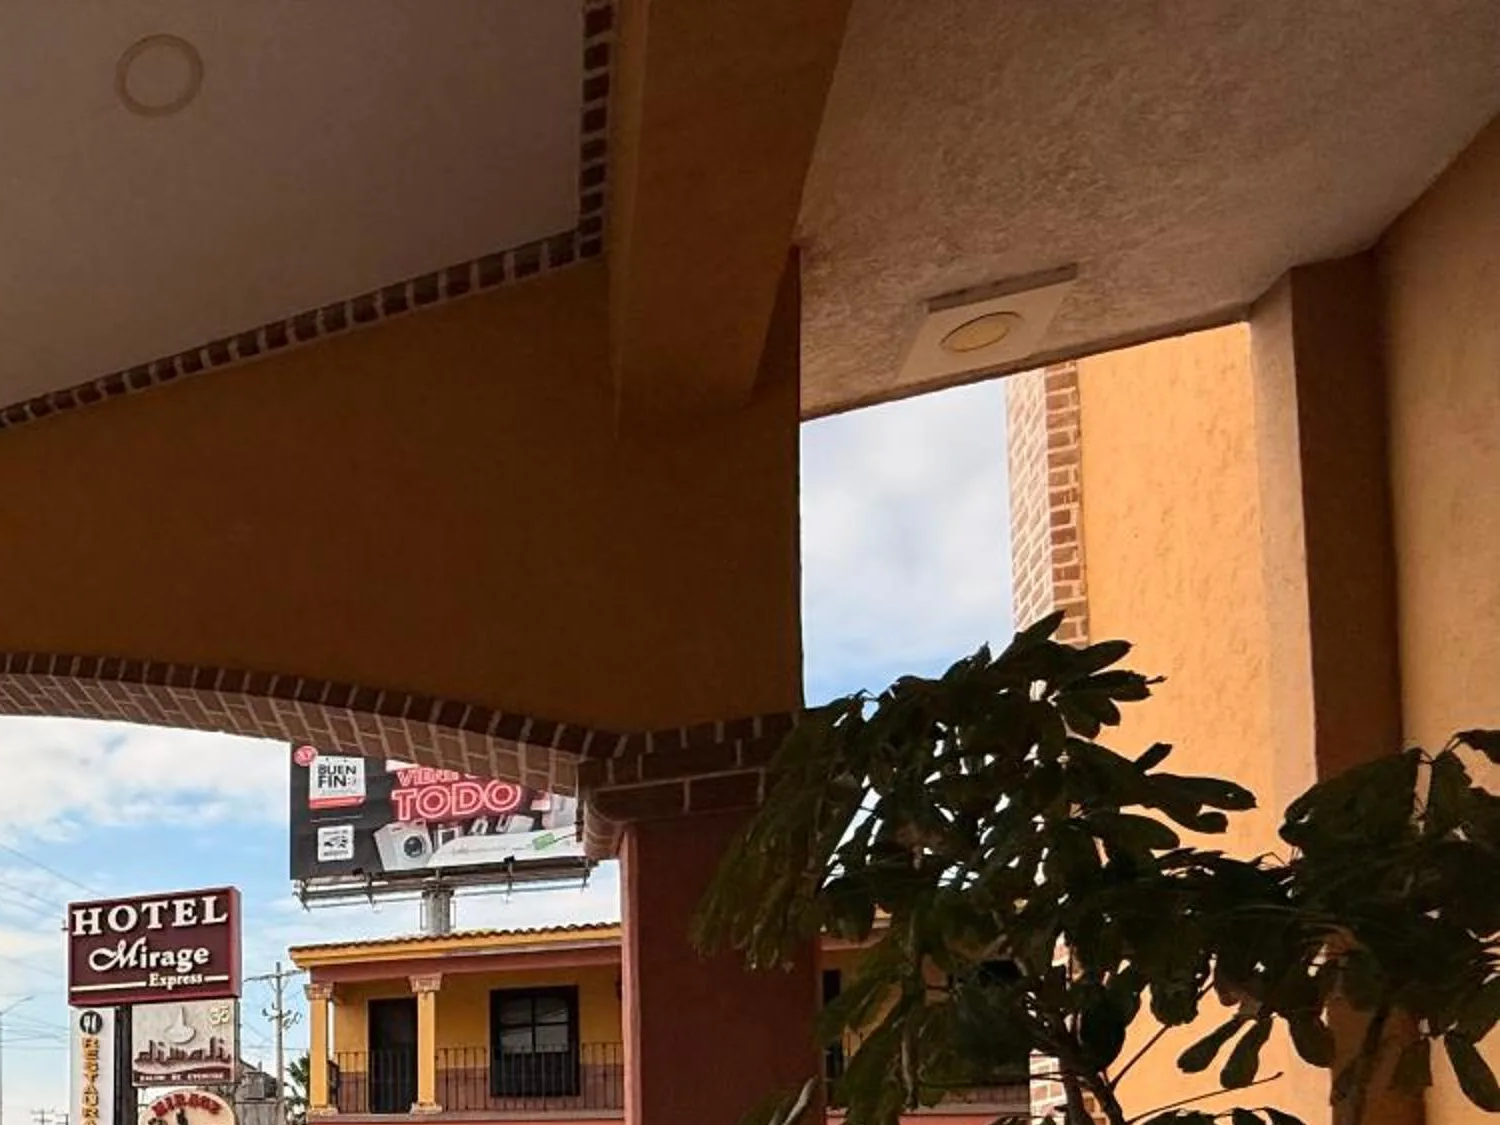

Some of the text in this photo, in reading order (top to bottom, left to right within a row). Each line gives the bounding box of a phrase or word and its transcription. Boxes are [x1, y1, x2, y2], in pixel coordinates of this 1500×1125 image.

[318, 764, 357, 775] BUEN
[391, 779, 522, 821] TODO
[72, 896, 228, 936] HOTEL
[89, 937, 209, 972] Mirage
[149, 973, 203, 990] Express
